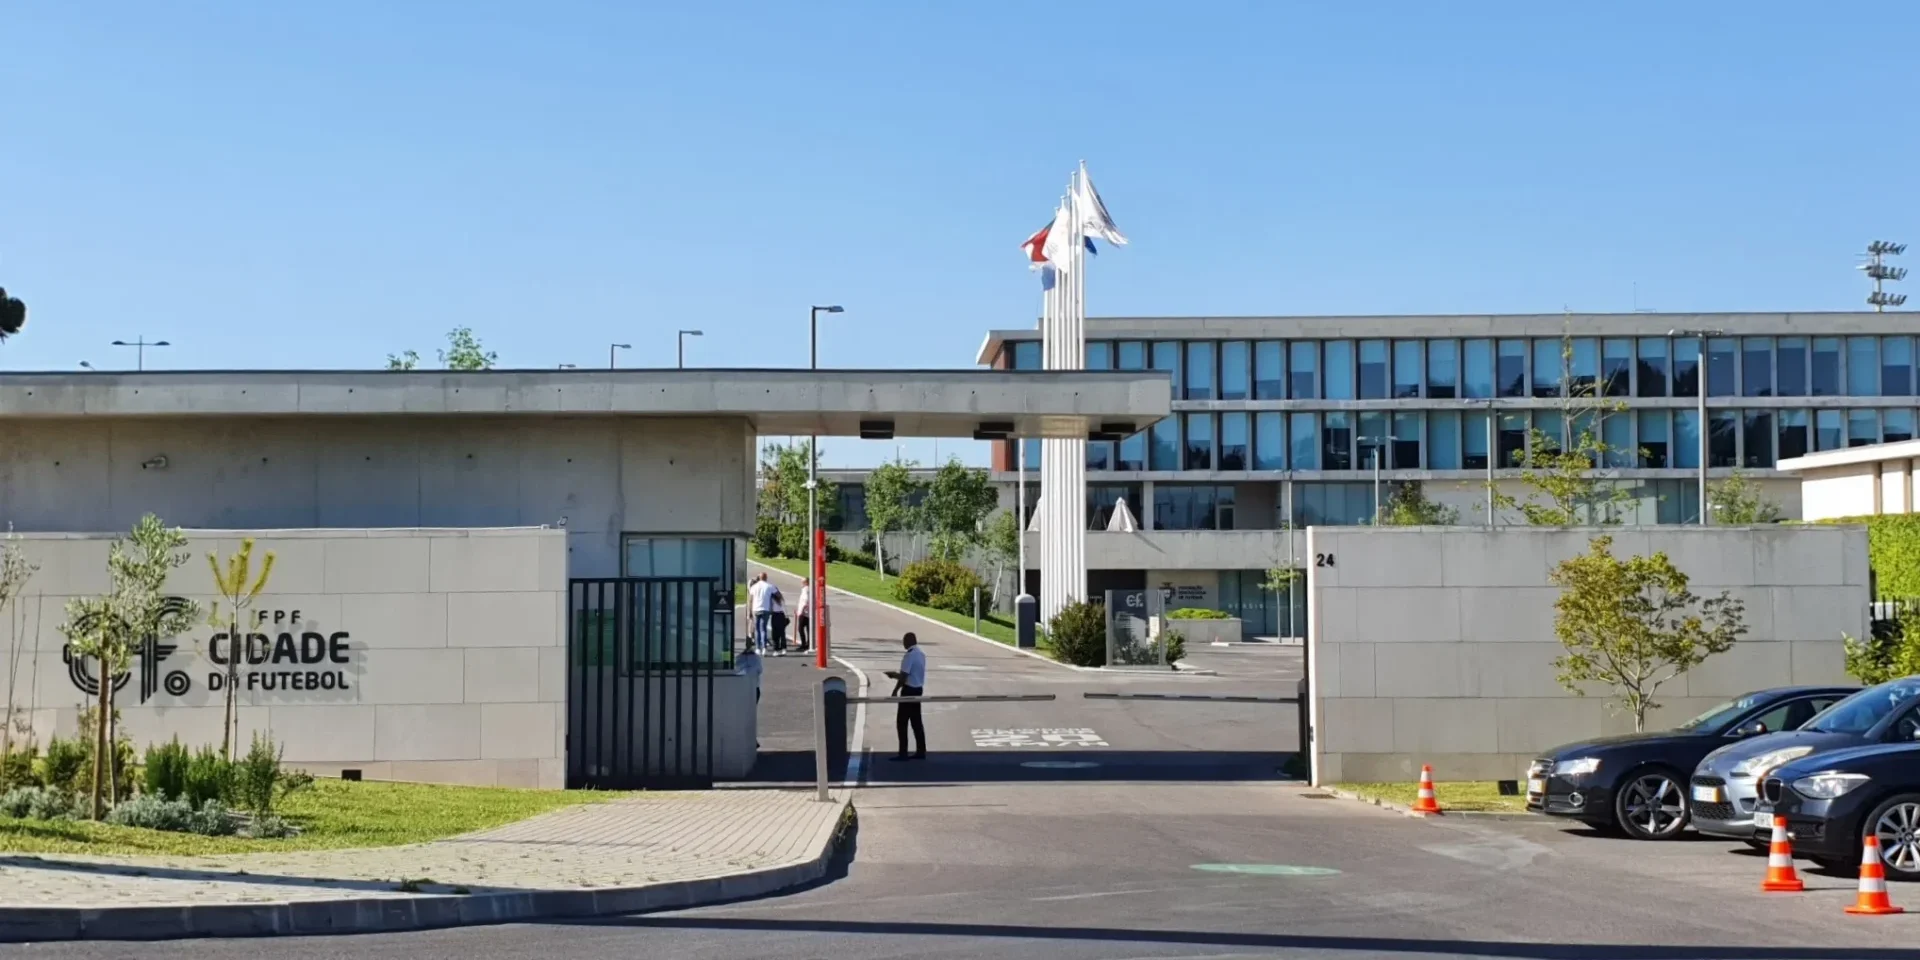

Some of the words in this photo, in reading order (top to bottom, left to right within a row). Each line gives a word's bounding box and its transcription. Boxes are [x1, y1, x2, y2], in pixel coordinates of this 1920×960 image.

[1316, 553, 1335, 567] 24
[208, 631, 350, 664] CIDADE
[247, 671, 349, 690] FUTEBOL
